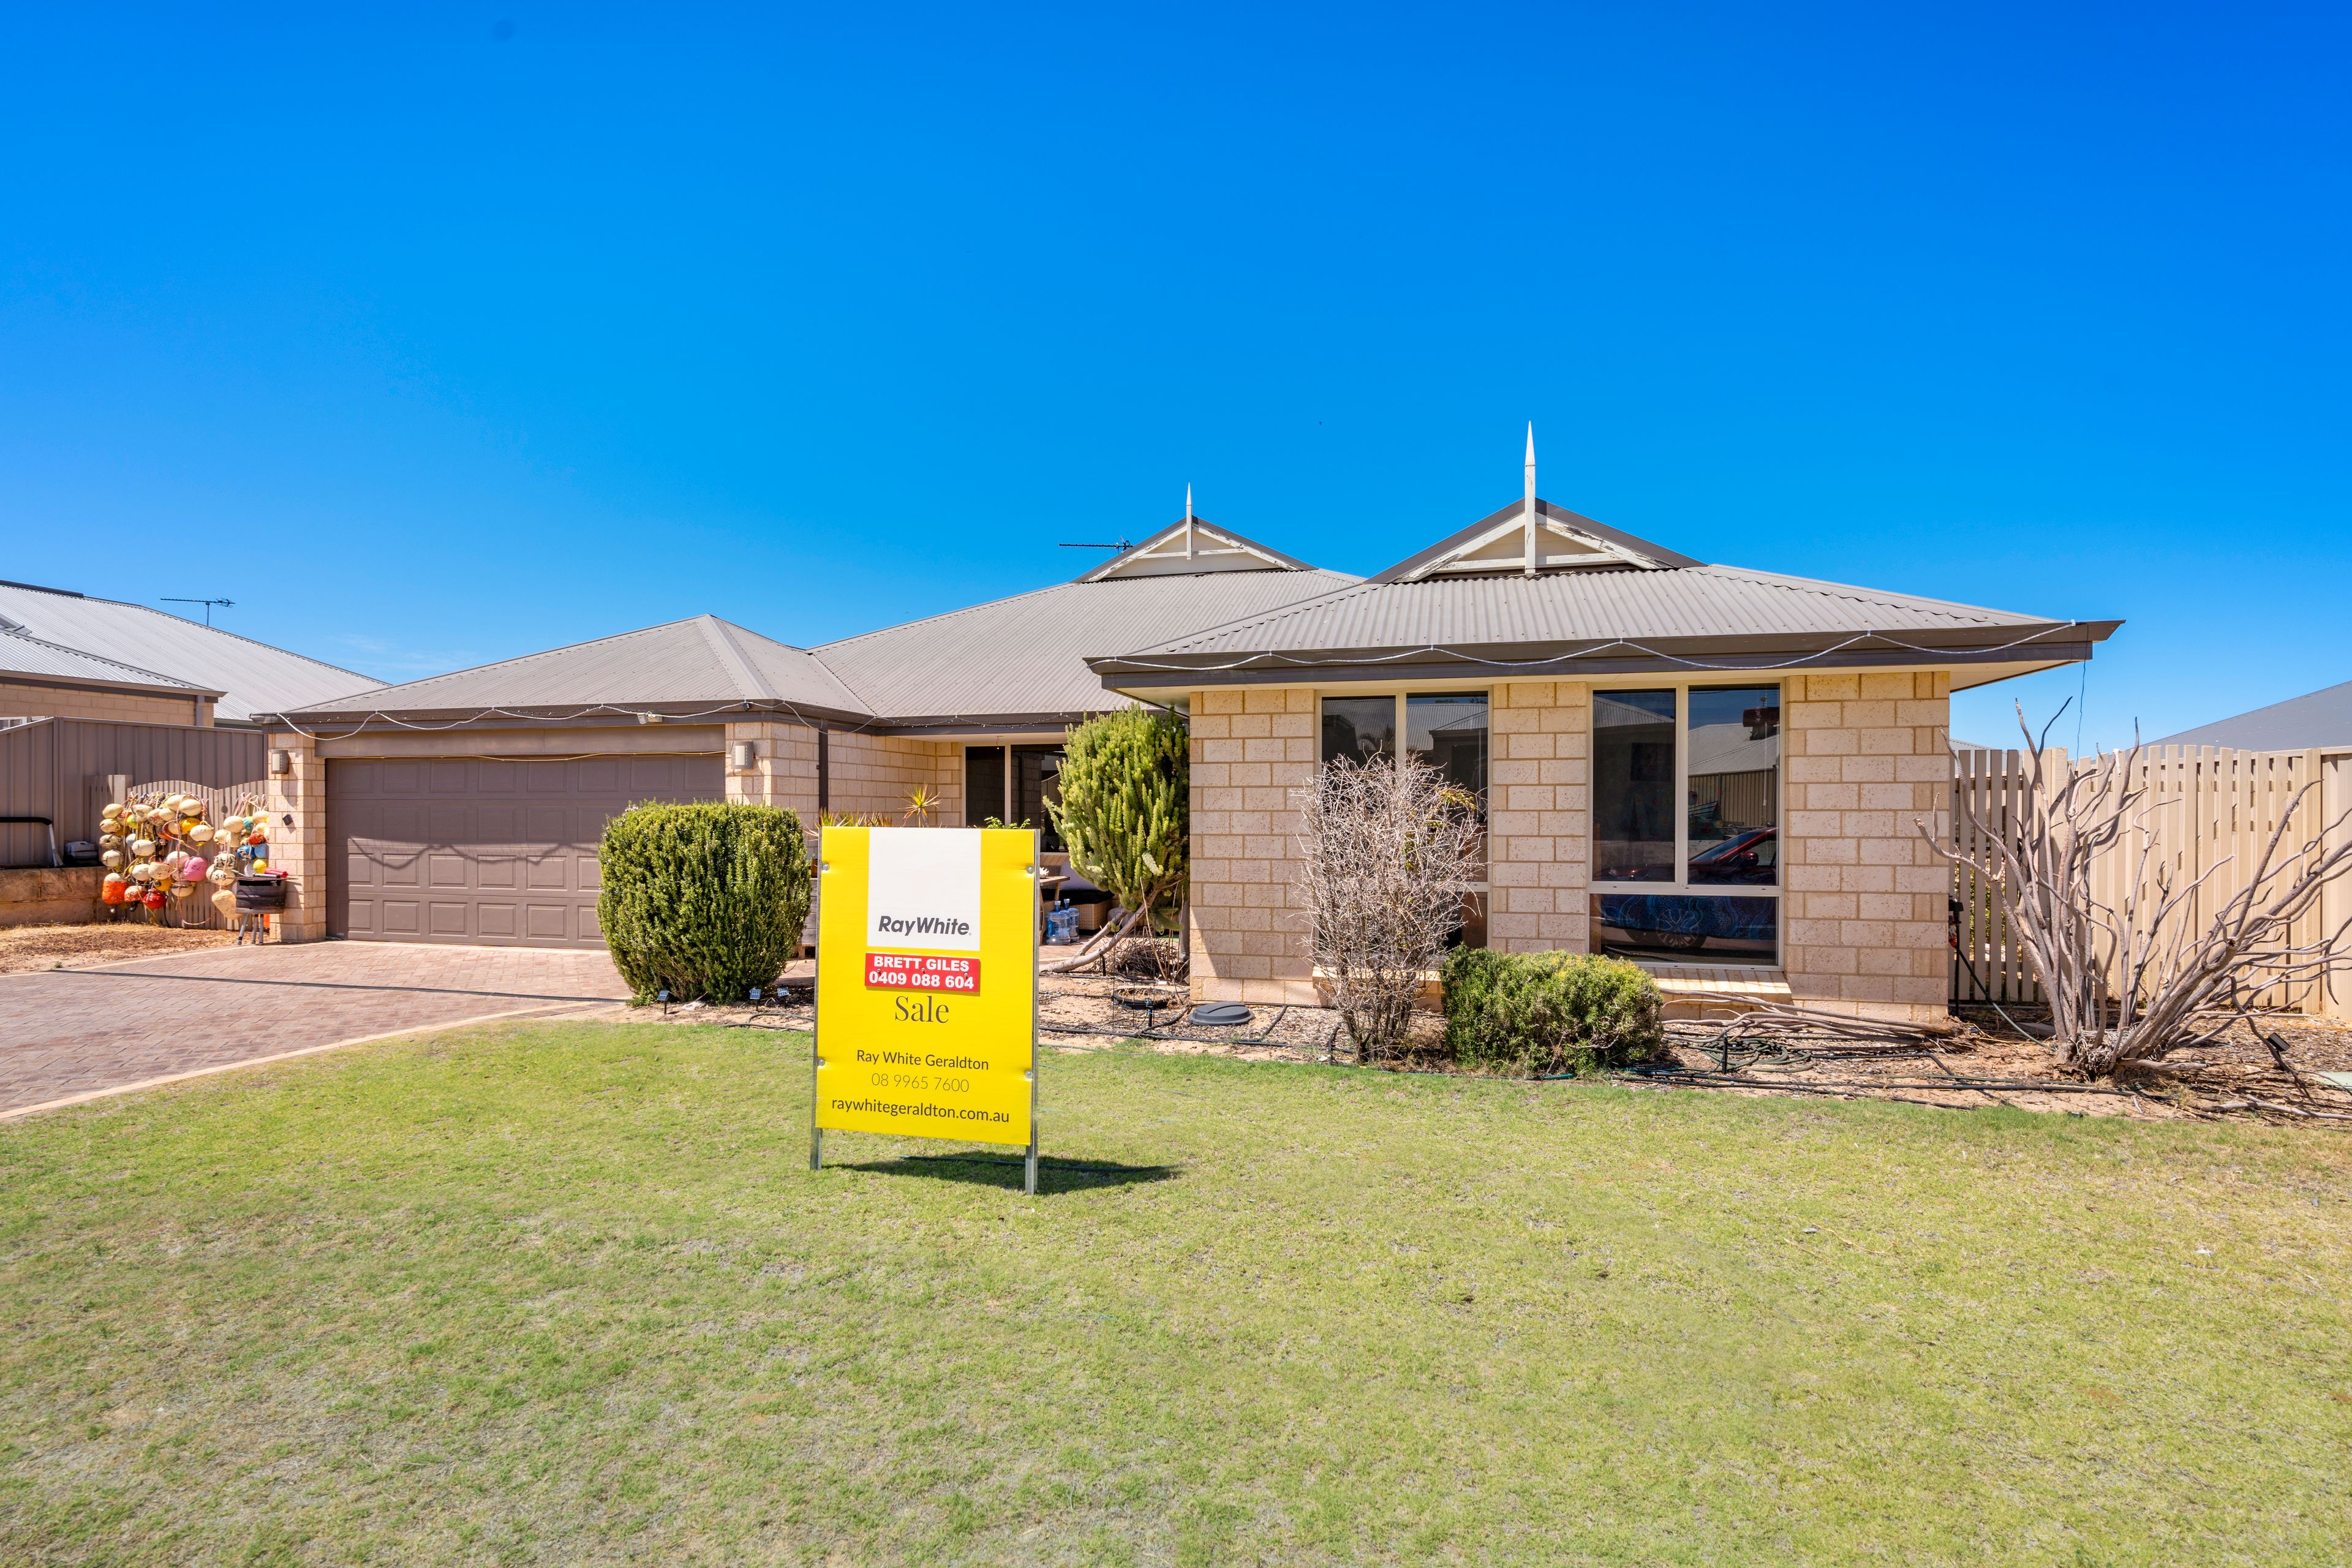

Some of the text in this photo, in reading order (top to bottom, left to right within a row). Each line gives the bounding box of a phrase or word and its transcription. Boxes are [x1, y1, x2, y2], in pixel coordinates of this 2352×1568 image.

[874, 956, 969, 972] BRETT GILES
[869, 971, 974, 989] 0409 088 604
[895, 995, 949, 1023] Sale
[857, 1050, 989, 1070] Ray White Geraldton
[871, 1073, 970, 1093] 08 9965 7600
[832, 1098, 1009, 1123] raywhitegeraldton.com.au
